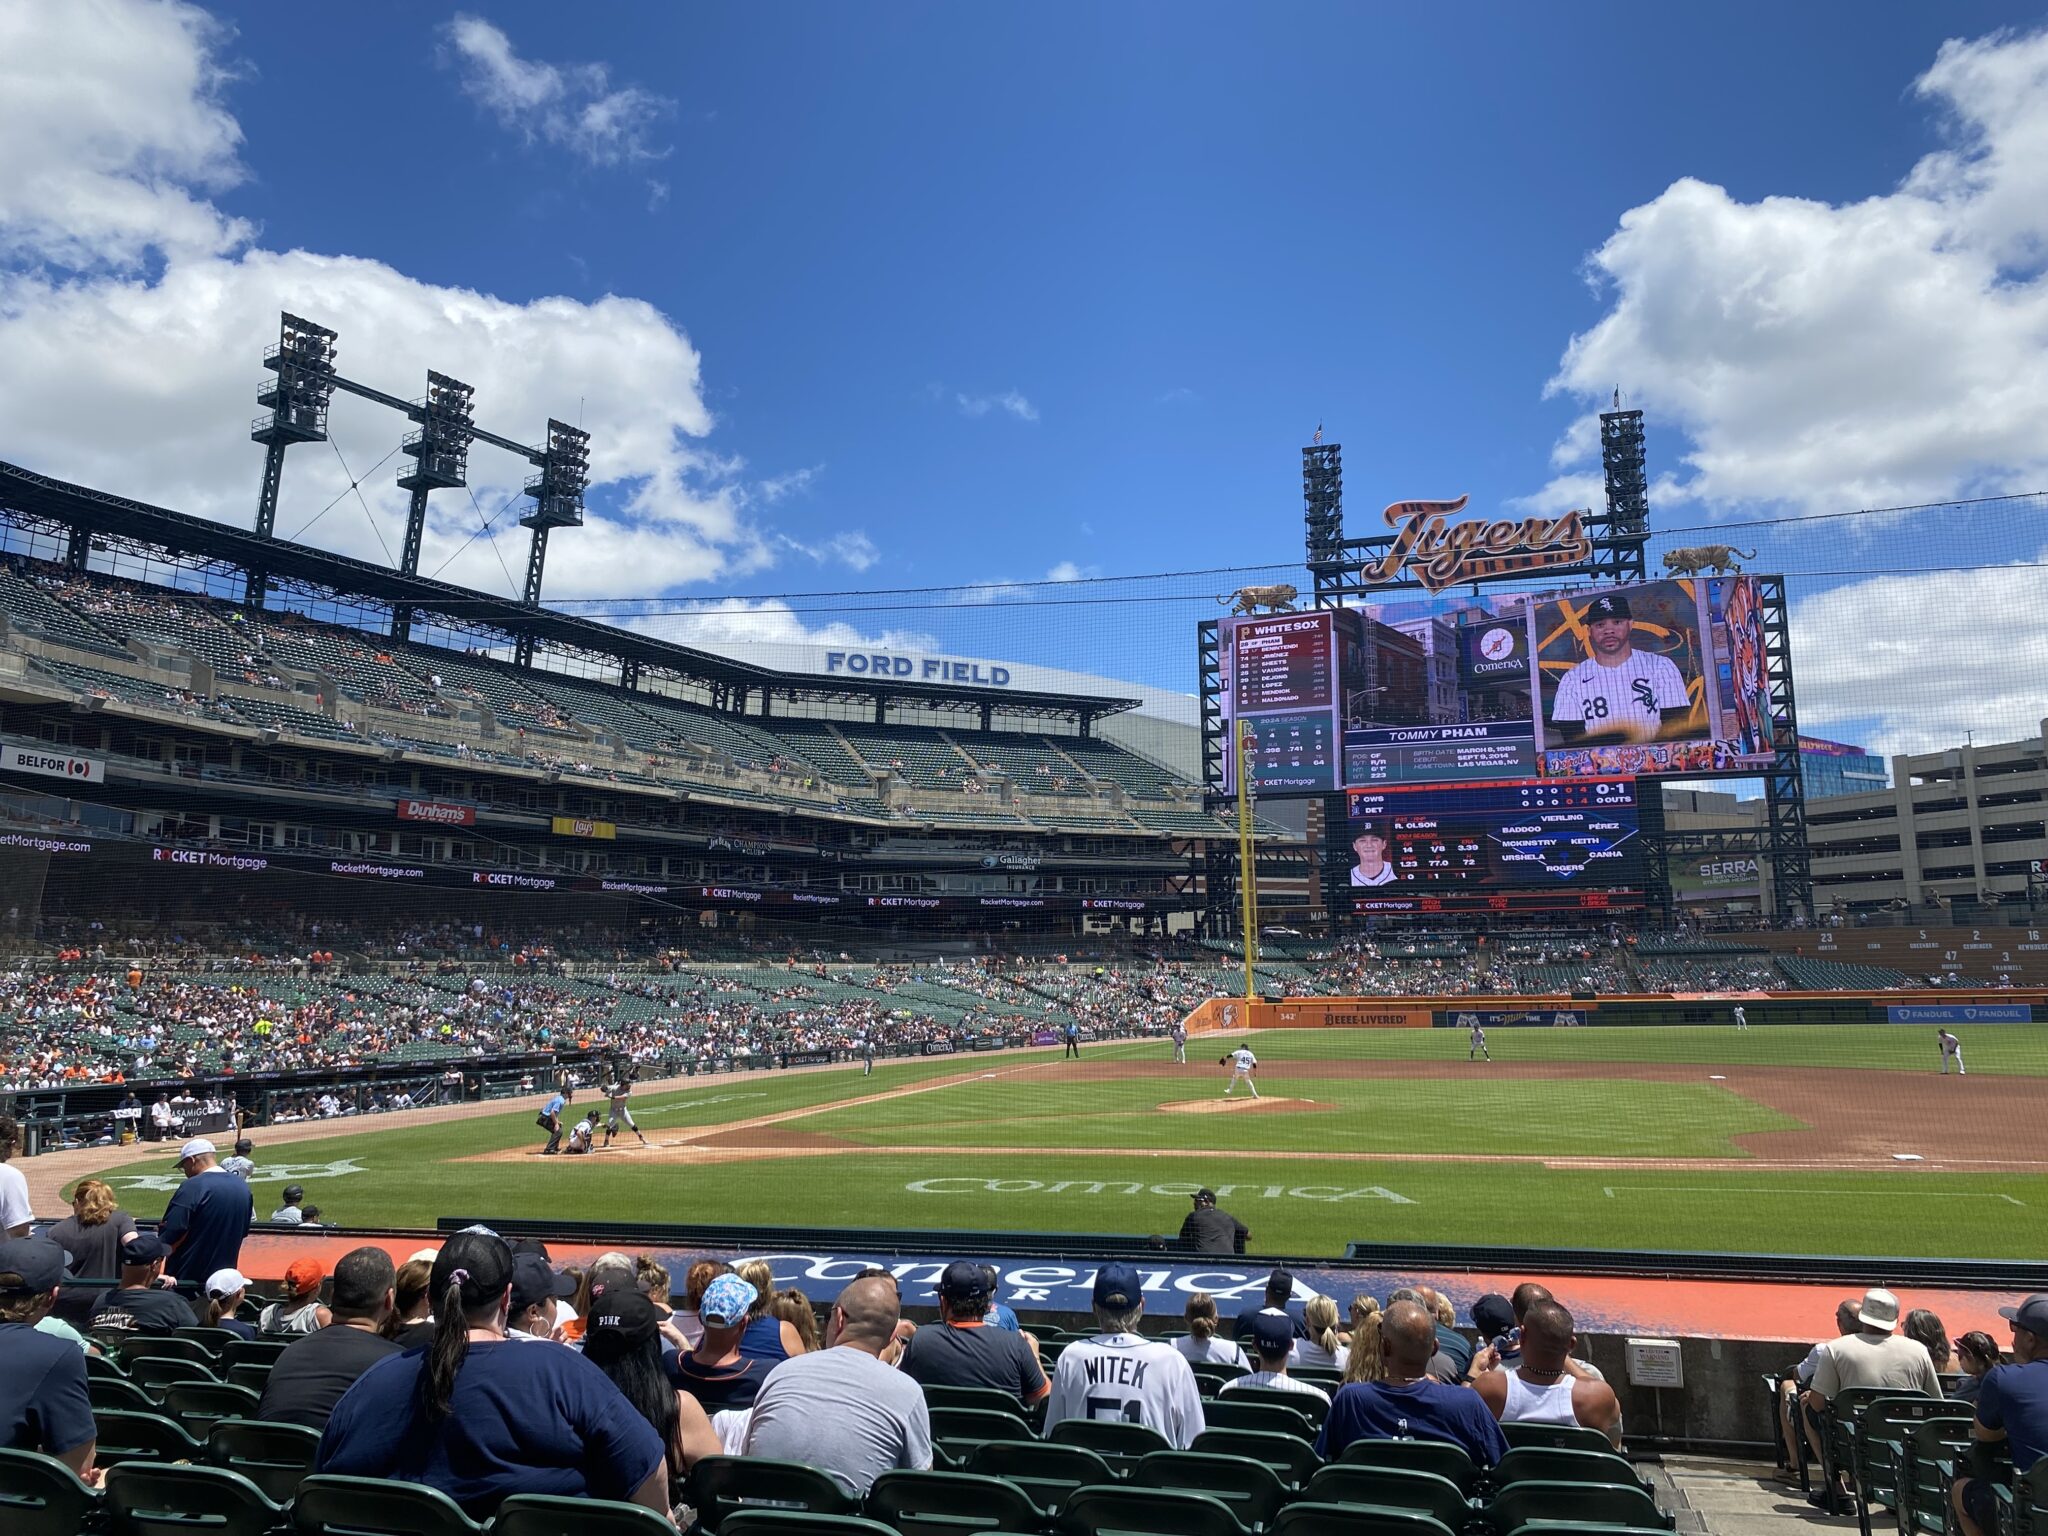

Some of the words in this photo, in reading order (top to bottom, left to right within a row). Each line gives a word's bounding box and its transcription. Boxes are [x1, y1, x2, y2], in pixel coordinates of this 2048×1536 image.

[1361, 493, 1592, 596] Tigers
[1254, 623, 1292, 635] WHITE
[1294, 620, 1319, 630] SOX
[1261, 644, 1298, 652] BENINTENDI
[826, 652, 913, 677] FORD
[923, 659, 1010, 686] FIELD
[1582, 697, 1608, 720] 28
[1389, 730, 1438, 741] TOMMY
[1442, 728, 1488, 738] PHAM
[17, 754, 65, 772] BELFOR
[1550, 751, 1590, 772] Detroit
[1283, 778, 1316, 786] Mortgage
[1596, 783, 1625, 794] 0-1
[408, 802, 465, 820] Dunham's
[1541, 814, 1583, 822] VIERLING
[574, 820, 593, 834] Lay's
[1589, 822, 1619, 830] PÉREZ
[734, 839, 772, 851] CHAMPIONS
[1502, 839, 1557, 847] MCKINSTRY
[153, 848, 206, 864] ROCKET
[208, 854, 267, 870] Mortgage
[1000, 855, 1042, 865] Gallagher
[332, 862, 423, 878] RocketMortgage.com
[1546, 864, 1584, 872] ROGERS
[1700, 860, 1759, 876] SERRA
[473, 873, 513, 884] ROCKET
[514, 876, 555, 889] Mortgage
[602, 882, 667, 893] RocketMortgage.com
[703, 888, 731, 897] ROCKET
[732, 890, 761, 901] Mortgage
[868, 898, 902, 906] ROCKET
[903, 898, 940, 907] Mortgage
[981, 898, 1043, 907] RocketMortgage.com
[1083, 900, 1112, 908] ROCKET
[1113, 901, 1145, 909] Mortgage
[1821, 933, 1832, 942] 23
[1920, 930, 1926, 939] 5
[1973, 930, 1980, 940] 2
[2028, 931, 2039, 940] 16
[1945, 951, 1957, 960] 47
[2002, 952, 2009, 961] 3
[1501, 1012, 1529, 1026] Miller
[1913, 1010, 1954, 1018] FANDUEL
[1979, 1010, 2021, 1018] FANDUEL
[599, 1316, 620, 1326] PINK
[1084, 1356, 1149, 1390] WITEK
